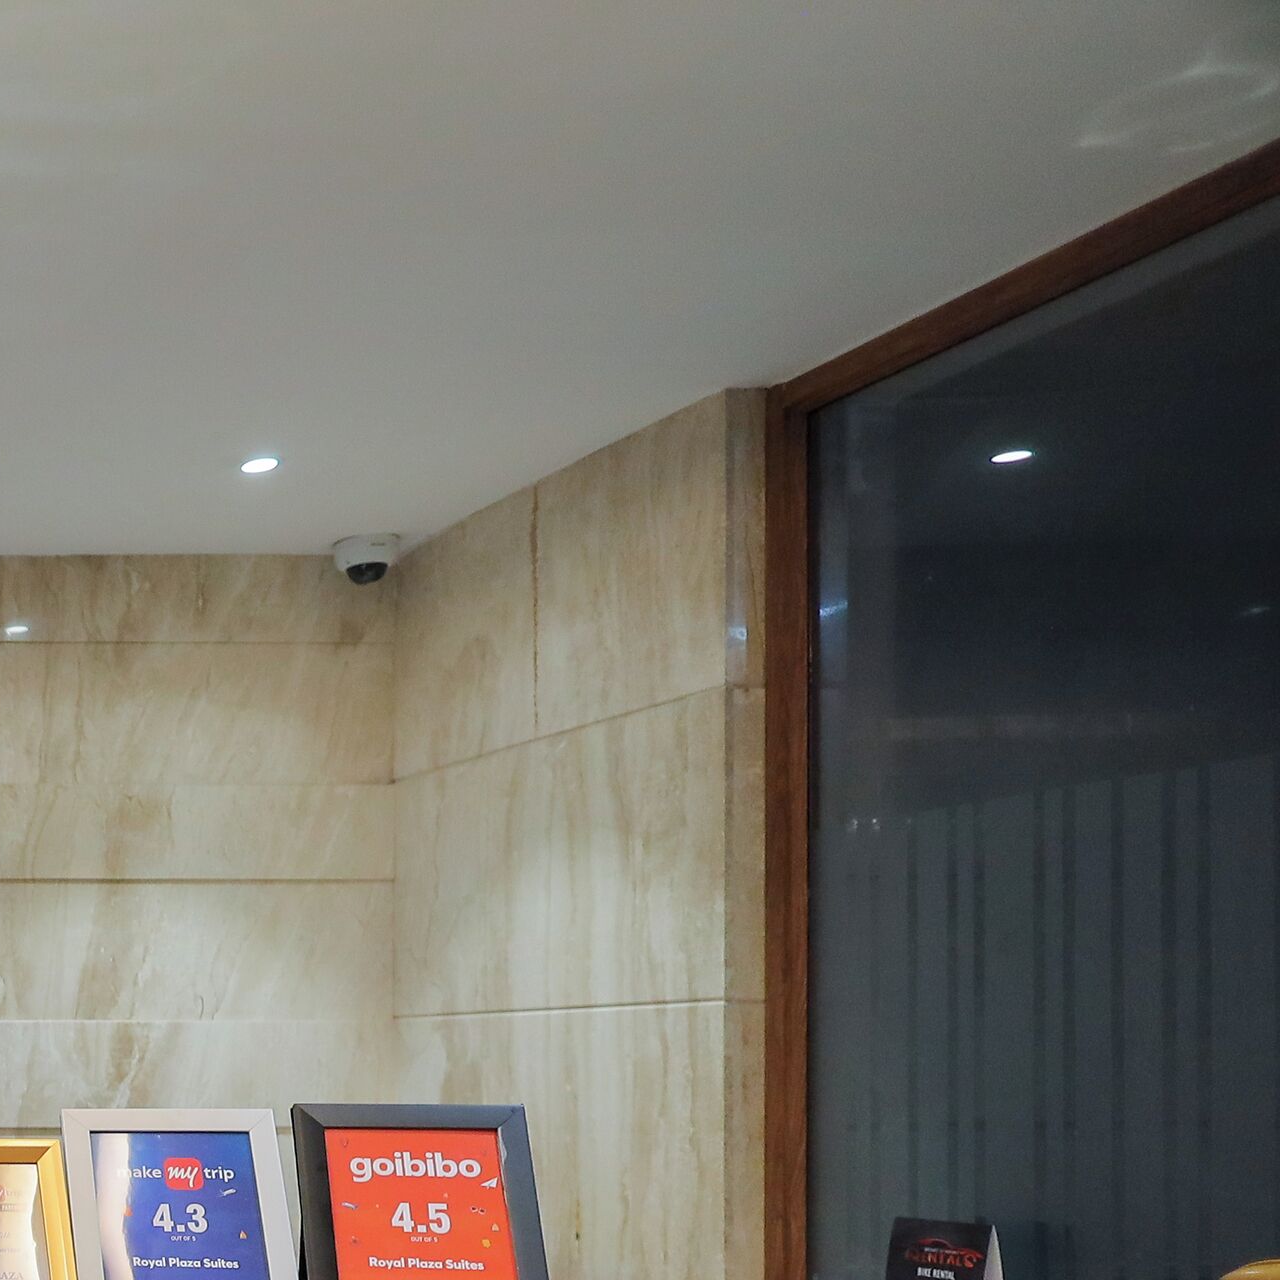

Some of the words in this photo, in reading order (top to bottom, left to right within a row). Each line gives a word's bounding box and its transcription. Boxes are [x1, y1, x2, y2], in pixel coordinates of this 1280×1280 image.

[167, 1165, 199, 1188] my
[203, 1165, 235, 1183] trip
[349, 1151, 482, 1183] goibibo
[152, 1202, 209, 1234] 4.3
[391, 1201, 451, 1235] 4.5
[132, 1256, 166, 1269] Royal
[168, 1257, 201, 1268] Plaza
[203, 1258, 240, 1269] Suites
[368, 1256, 405, 1270] Royal
[407, 1257, 443, 1269] Plaza
[445, 1259, 485, 1271] Suites
[917, 1266, 931, 1278] BIKE
[932, 1268, 955, 1280] RENTAL
